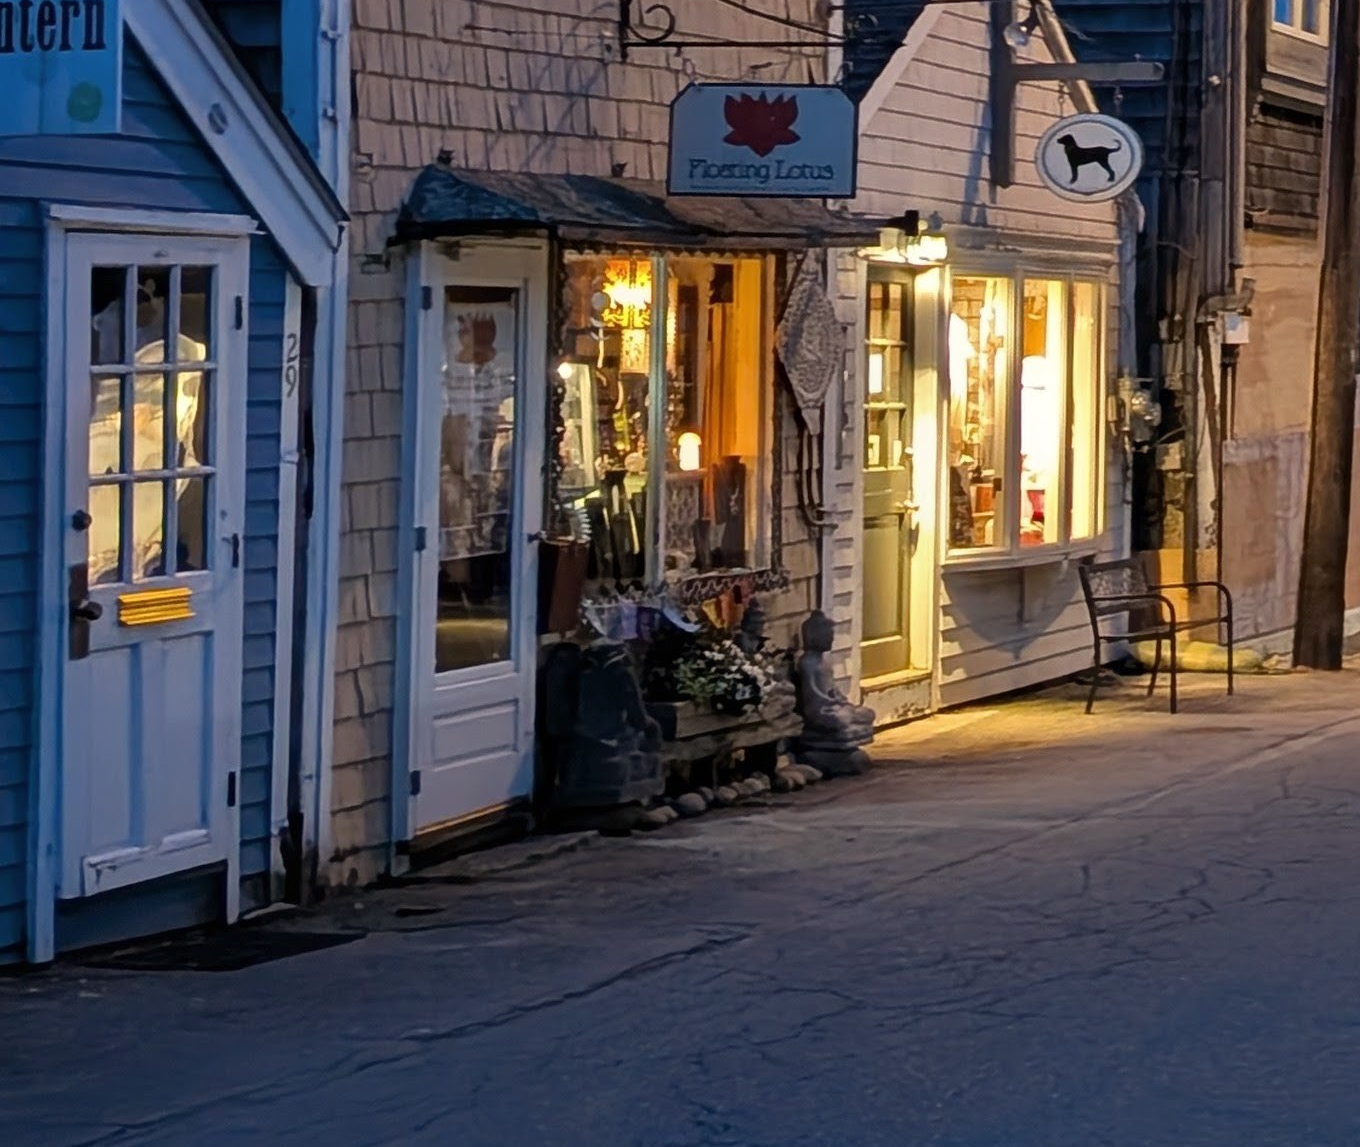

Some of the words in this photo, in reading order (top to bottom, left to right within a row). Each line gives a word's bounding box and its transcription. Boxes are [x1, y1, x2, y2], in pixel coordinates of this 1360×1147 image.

[688, 158, 770, 184] Floating
[774, 159, 835, 180] Lotus
[284, 332, 299, 399] 29
